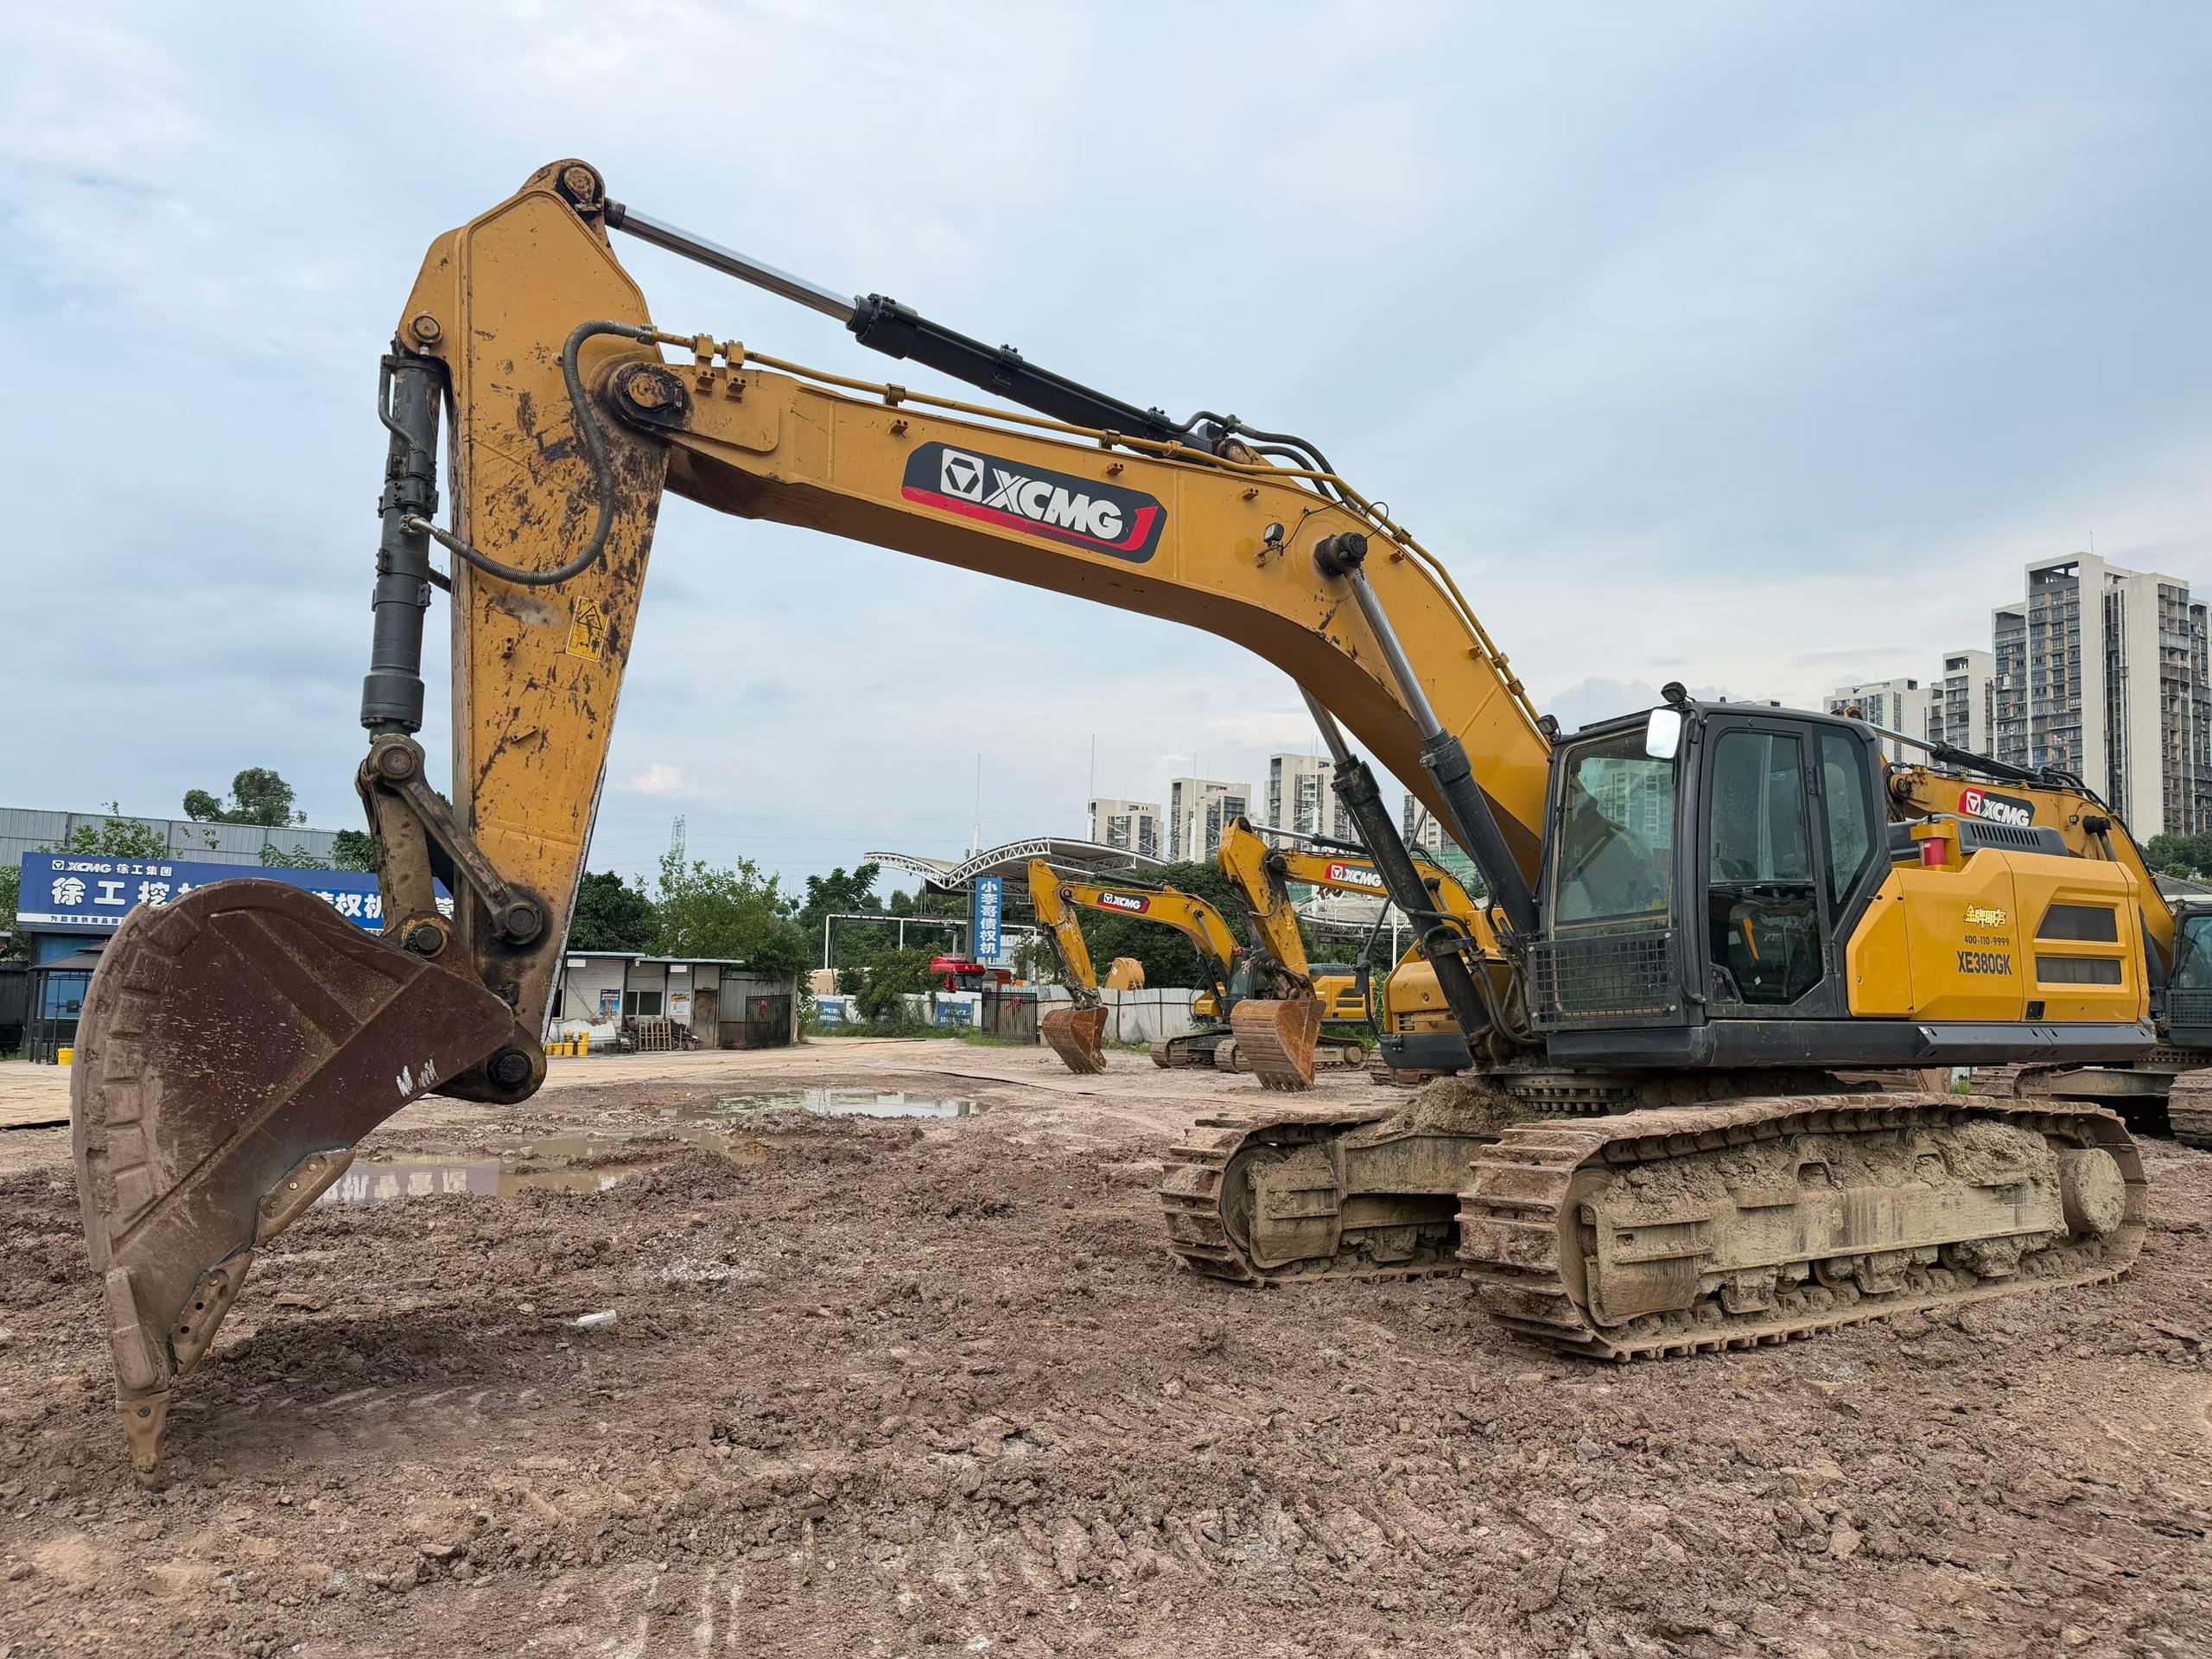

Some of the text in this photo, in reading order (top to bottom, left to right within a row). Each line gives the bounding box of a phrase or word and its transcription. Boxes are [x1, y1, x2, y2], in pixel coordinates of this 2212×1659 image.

[982, 467, 1122, 539] XCMG
[1980, 798, 2030, 827] XCMG
[65, 861, 172, 877] XCMG 徐工集团
[1342, 868, 1382, 887] XCMG
[52, 877, 206, 907] 徐工挖
[1112, 896, 1141, 910] XCMG
[980, 880, 998, 955] 小李哥债权机
[1964, 935, 2010, 946] 400-110-9999
[1956, 950, 2012, 976] XE380GK
